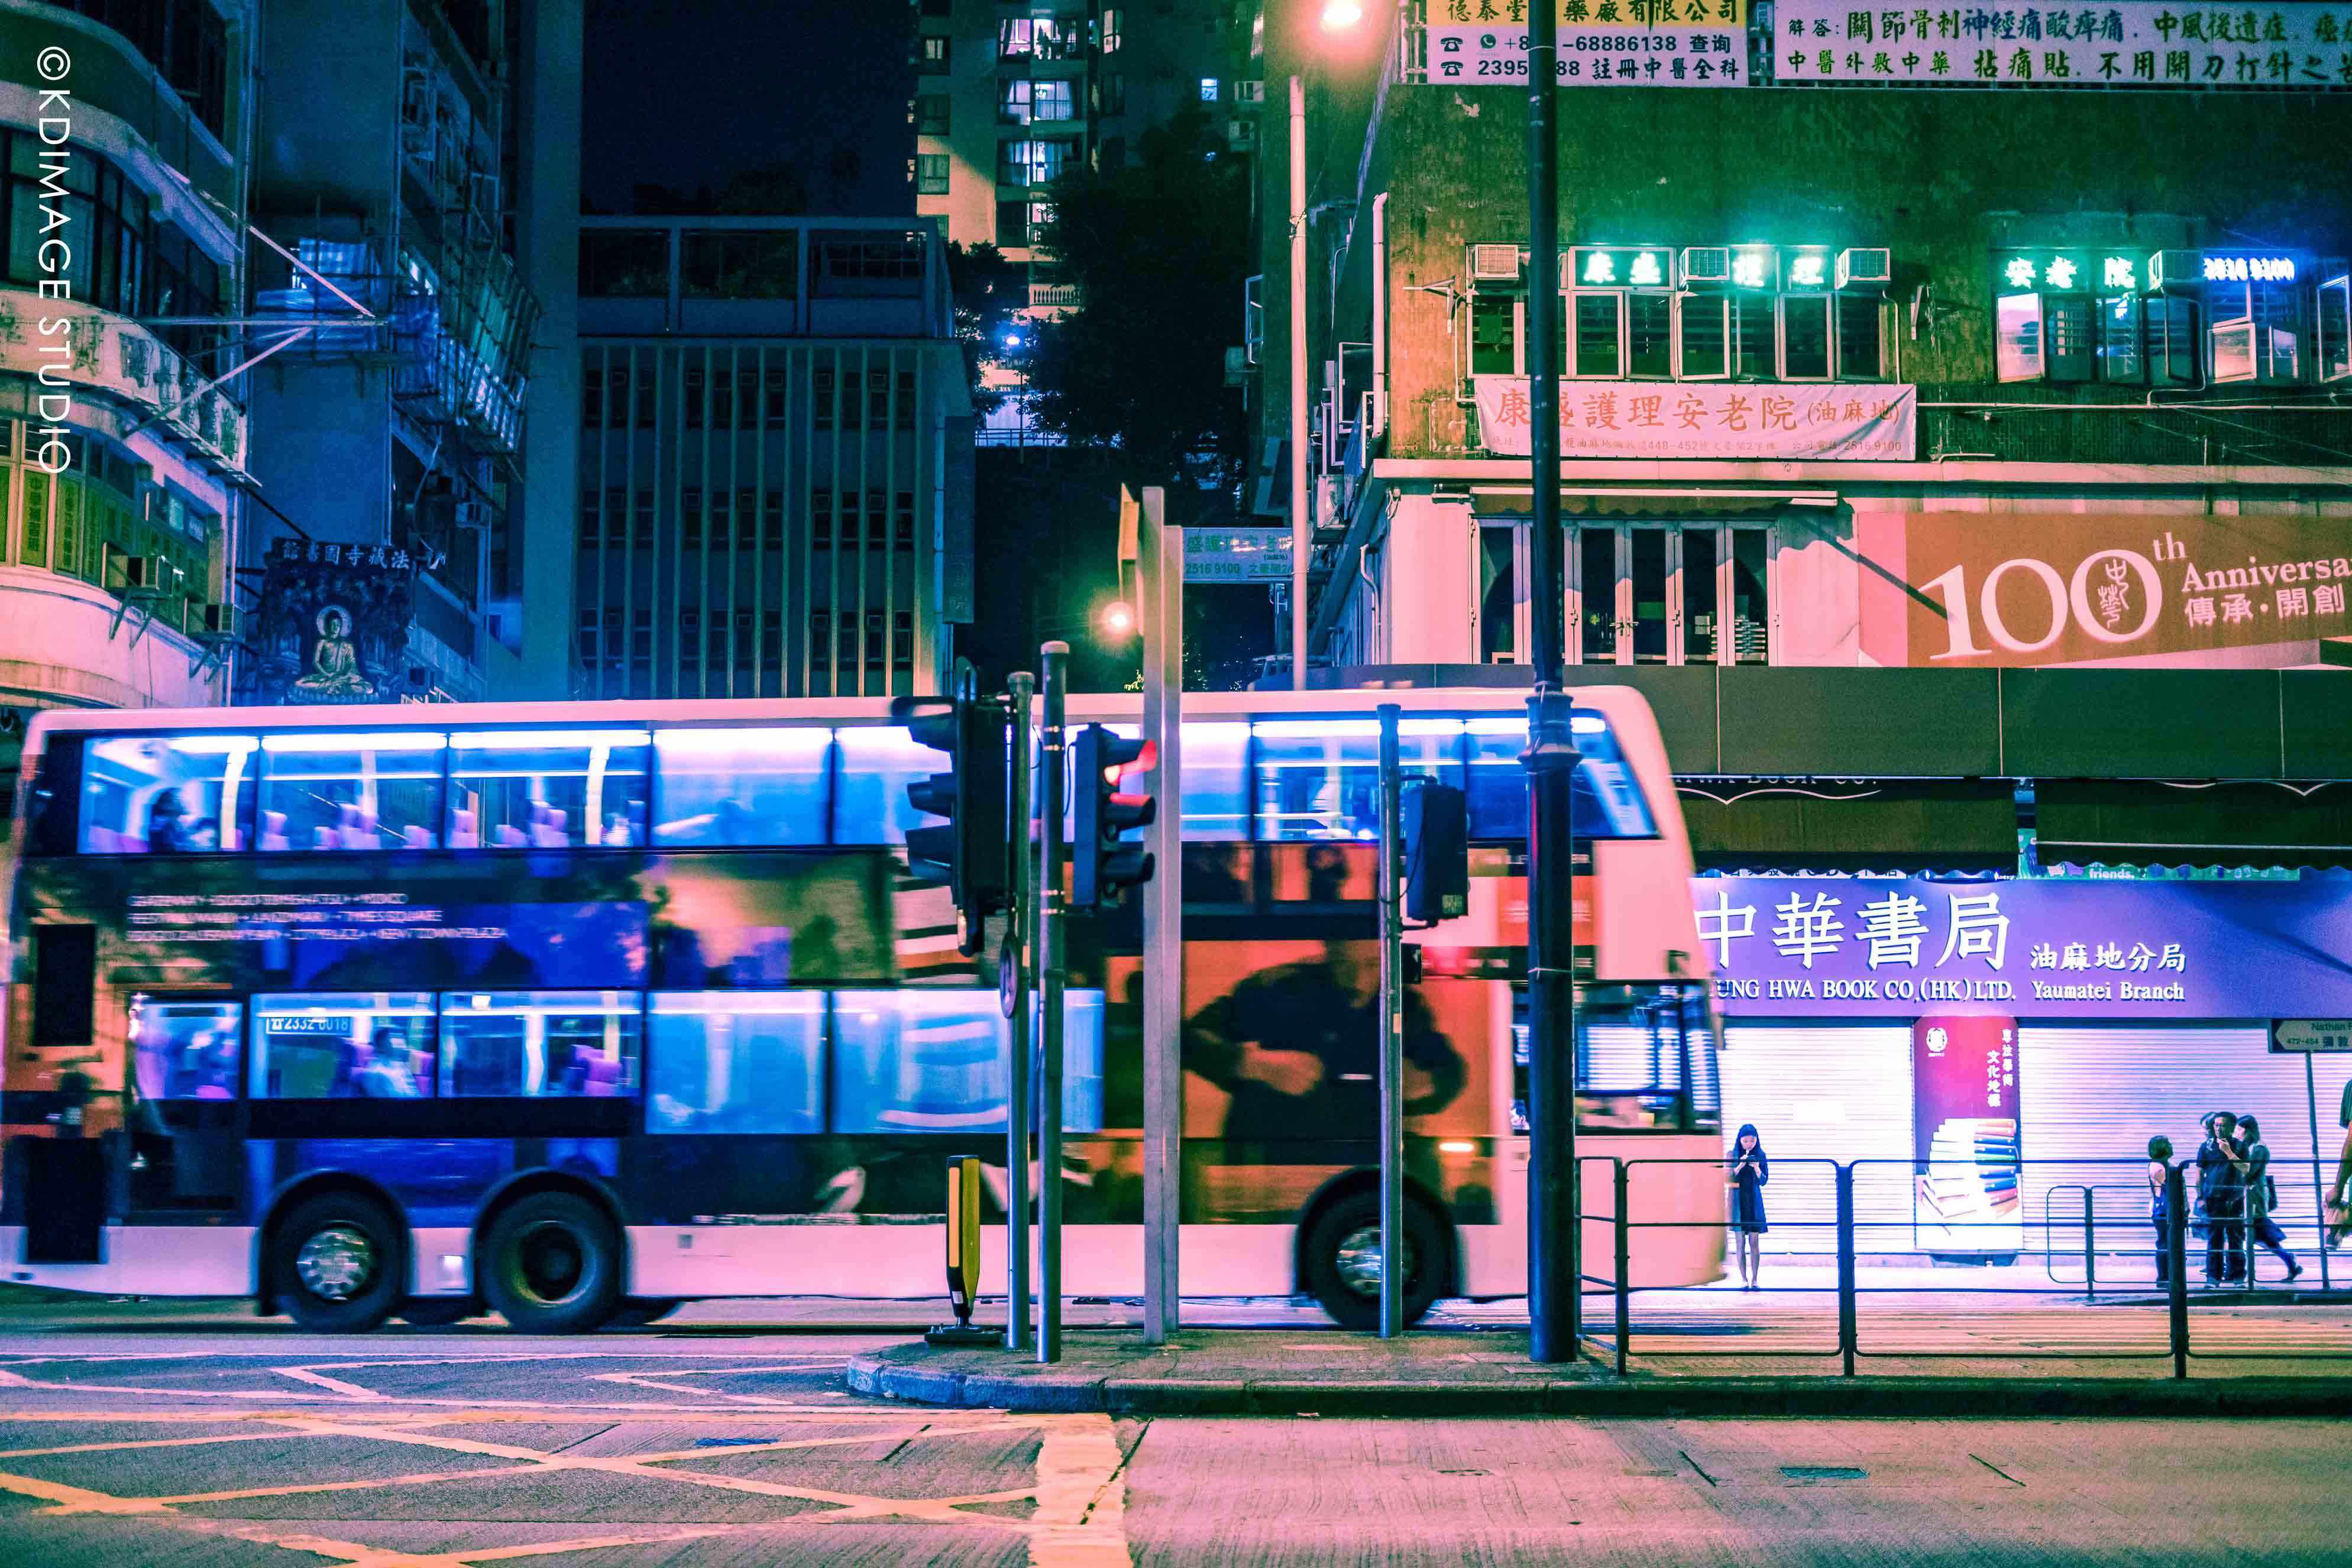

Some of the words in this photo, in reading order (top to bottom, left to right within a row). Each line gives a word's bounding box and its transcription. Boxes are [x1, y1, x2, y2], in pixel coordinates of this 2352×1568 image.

[1448, 0, 1738, 22] 德泰堂藥廠有限公司
[1505, 36, 1677, 51] +8-68886138
[1479, 60, 1580, 76] 239588
[2182, 556, 2352, 593] Anniversa
[1694, 889, 2011, 971] 中華書局
[2030, 942, 2186, 973] 油麻地分局
[1709, 979, 1760, 999] UNG
[1768, 979, 1814, 999] HWA
[1822, 979, 1878, 999] BOOK
[2031, 981, 2112, 1000] Yaumatei
[2120, 981, 2186, 1001] Branch
